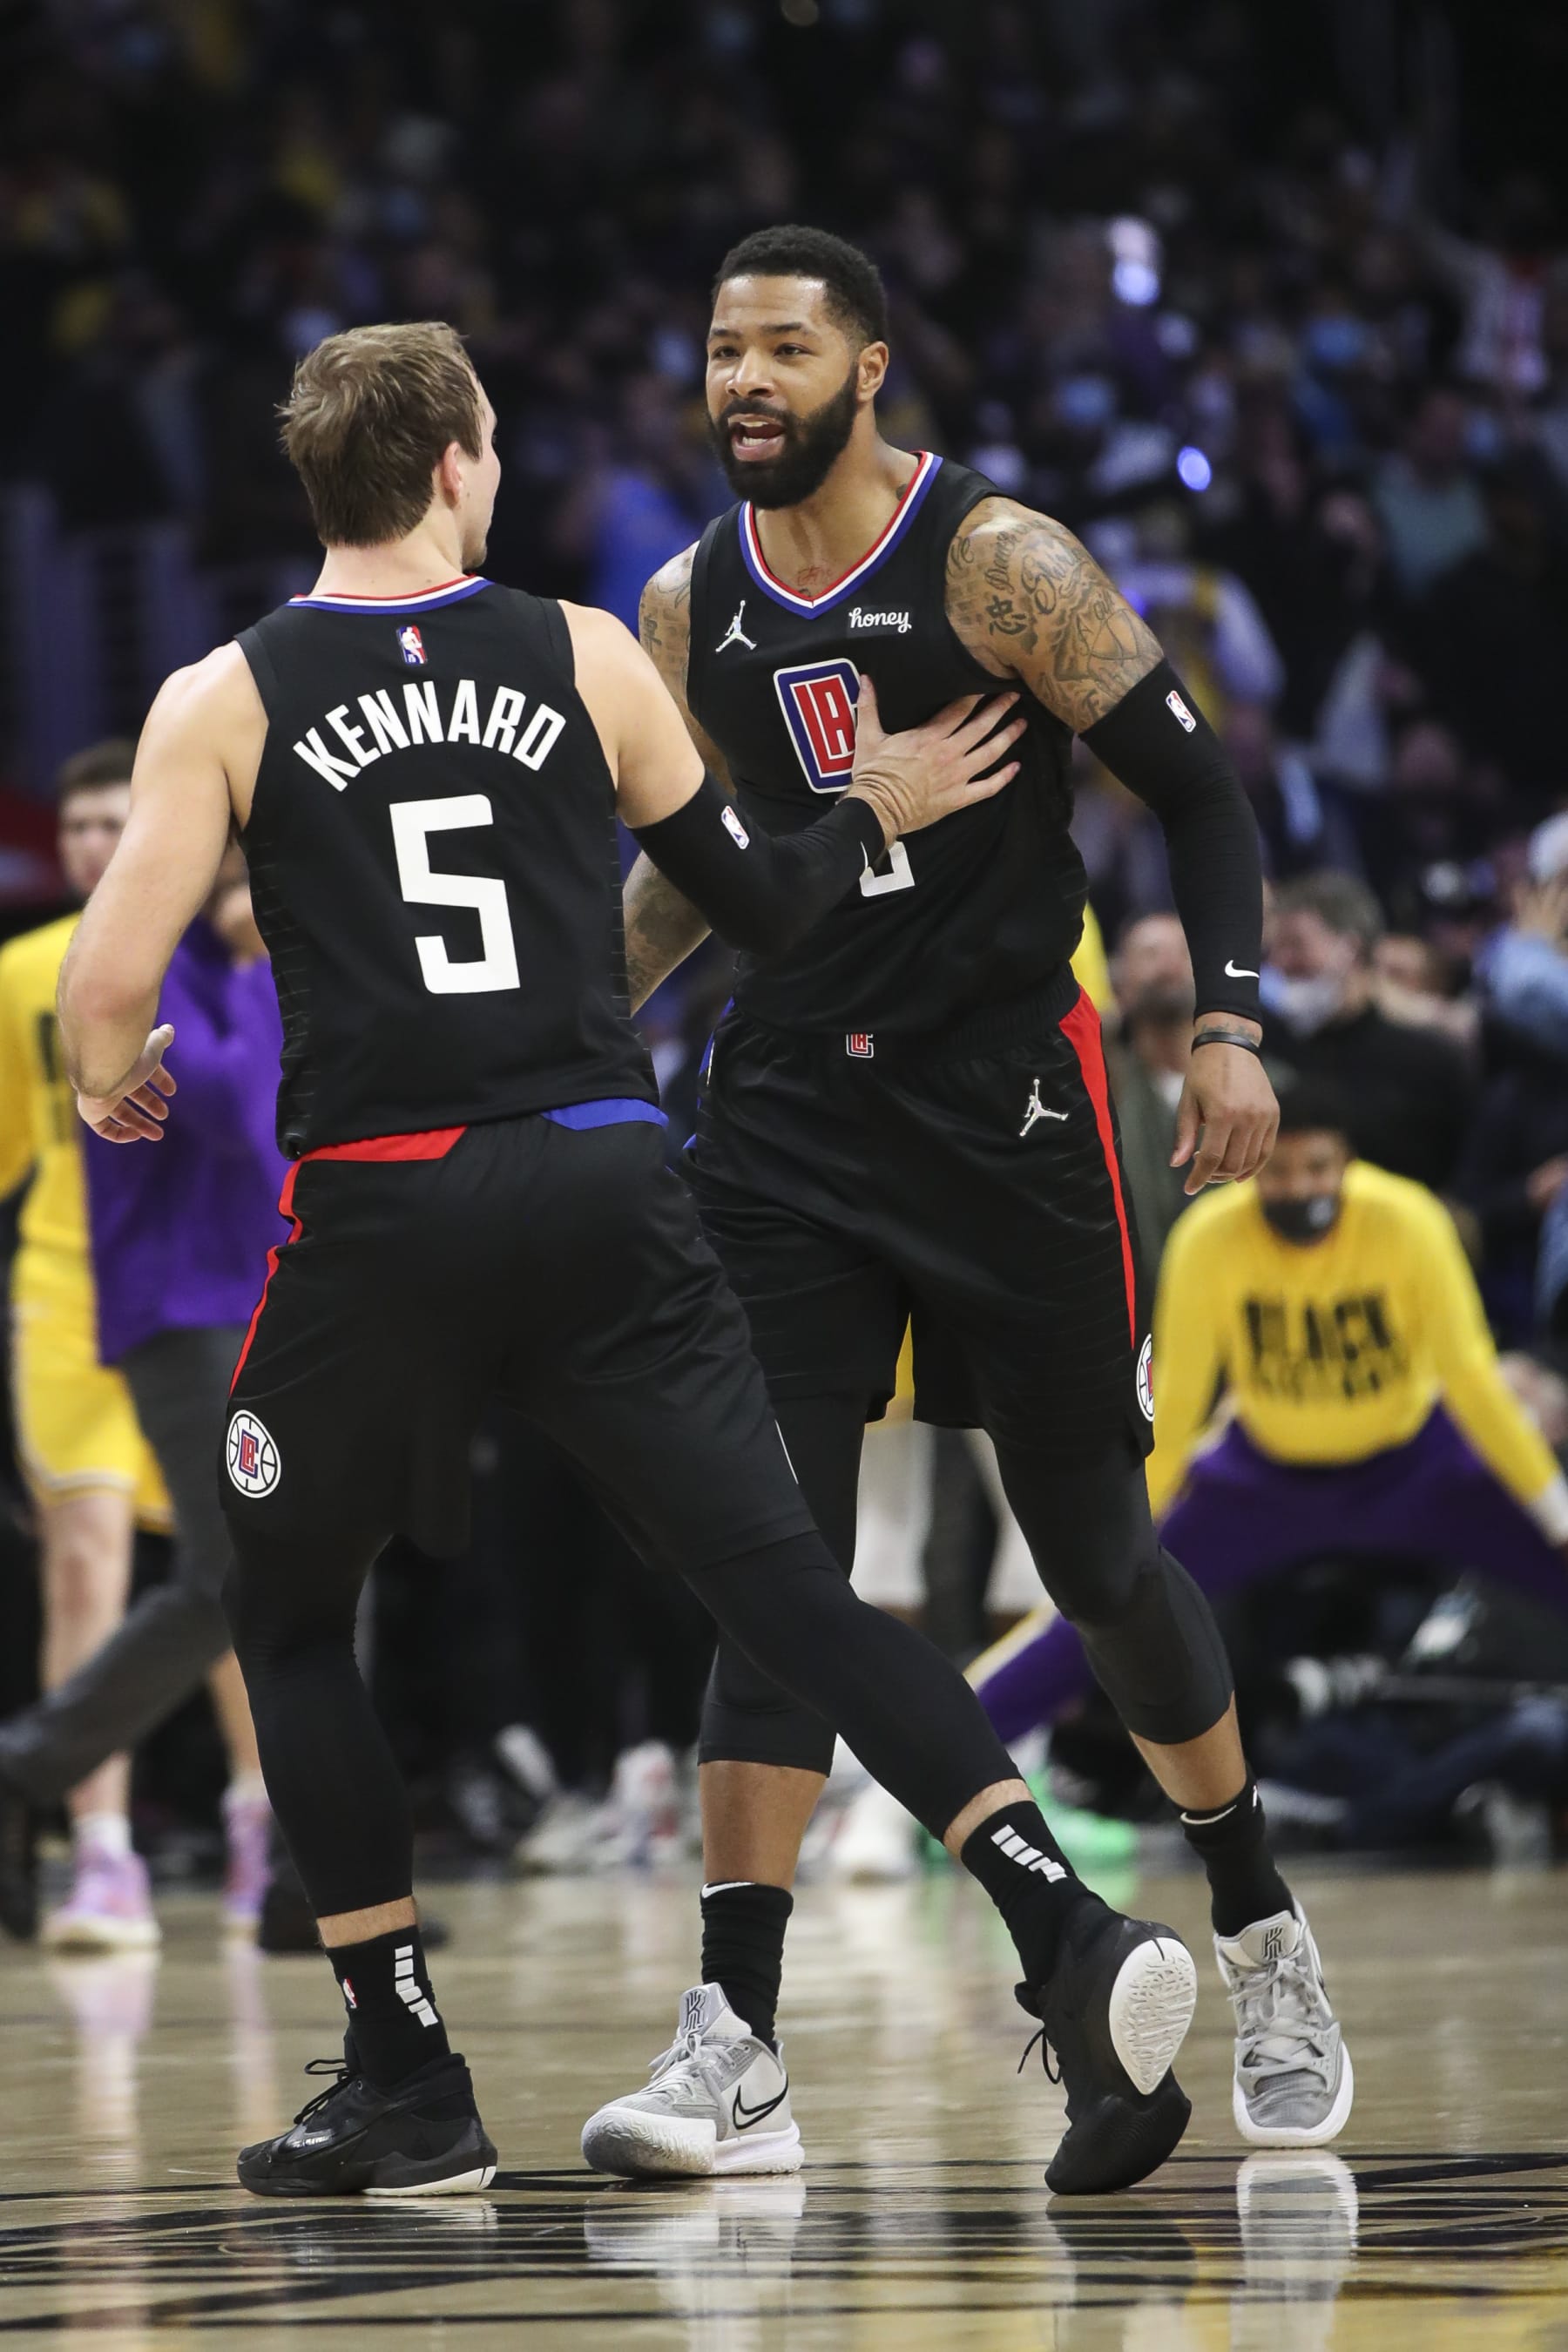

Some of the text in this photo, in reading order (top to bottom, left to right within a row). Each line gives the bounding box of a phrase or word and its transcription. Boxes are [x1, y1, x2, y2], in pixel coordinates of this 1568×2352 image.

[848, 607, 912, 633] honey
[293, 679, 566, 792] KENNARD
[389, 794, 521, 995] 5
